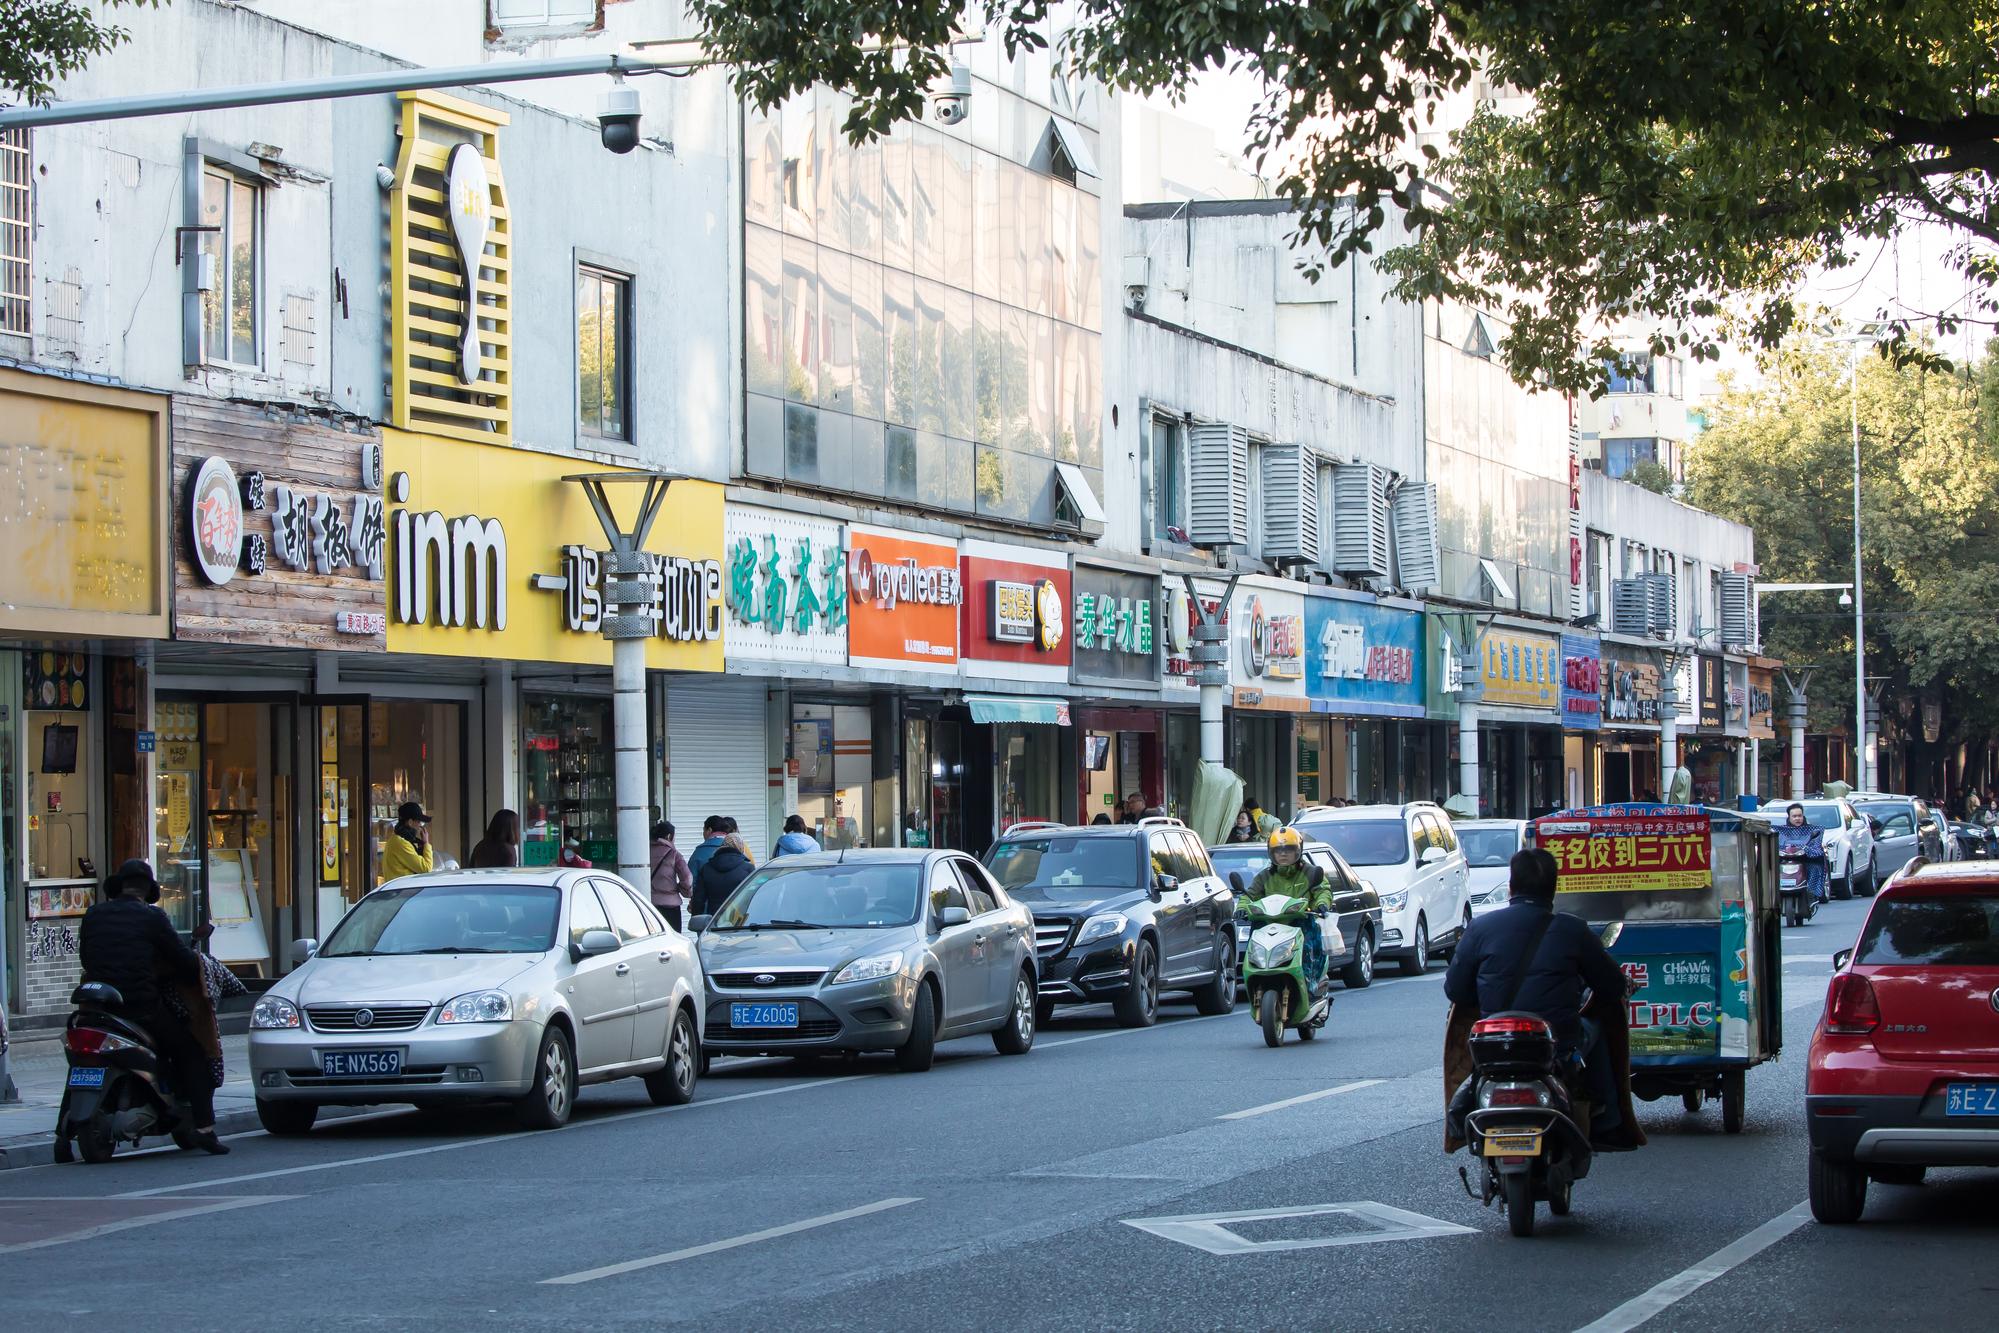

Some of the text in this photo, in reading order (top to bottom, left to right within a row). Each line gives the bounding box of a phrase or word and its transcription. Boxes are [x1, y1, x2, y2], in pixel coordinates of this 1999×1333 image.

[274, 486, 386, 581] 胡椒饼
[391, 471, 507, 632] inm
[874, 558, 938, 611] royaltea
[1078, 592, 1152, 655] 泰华水晶
[1664, 974, 1710, 985] 春华教育
[1883, 1024, 1928, 1033] 上海大众
